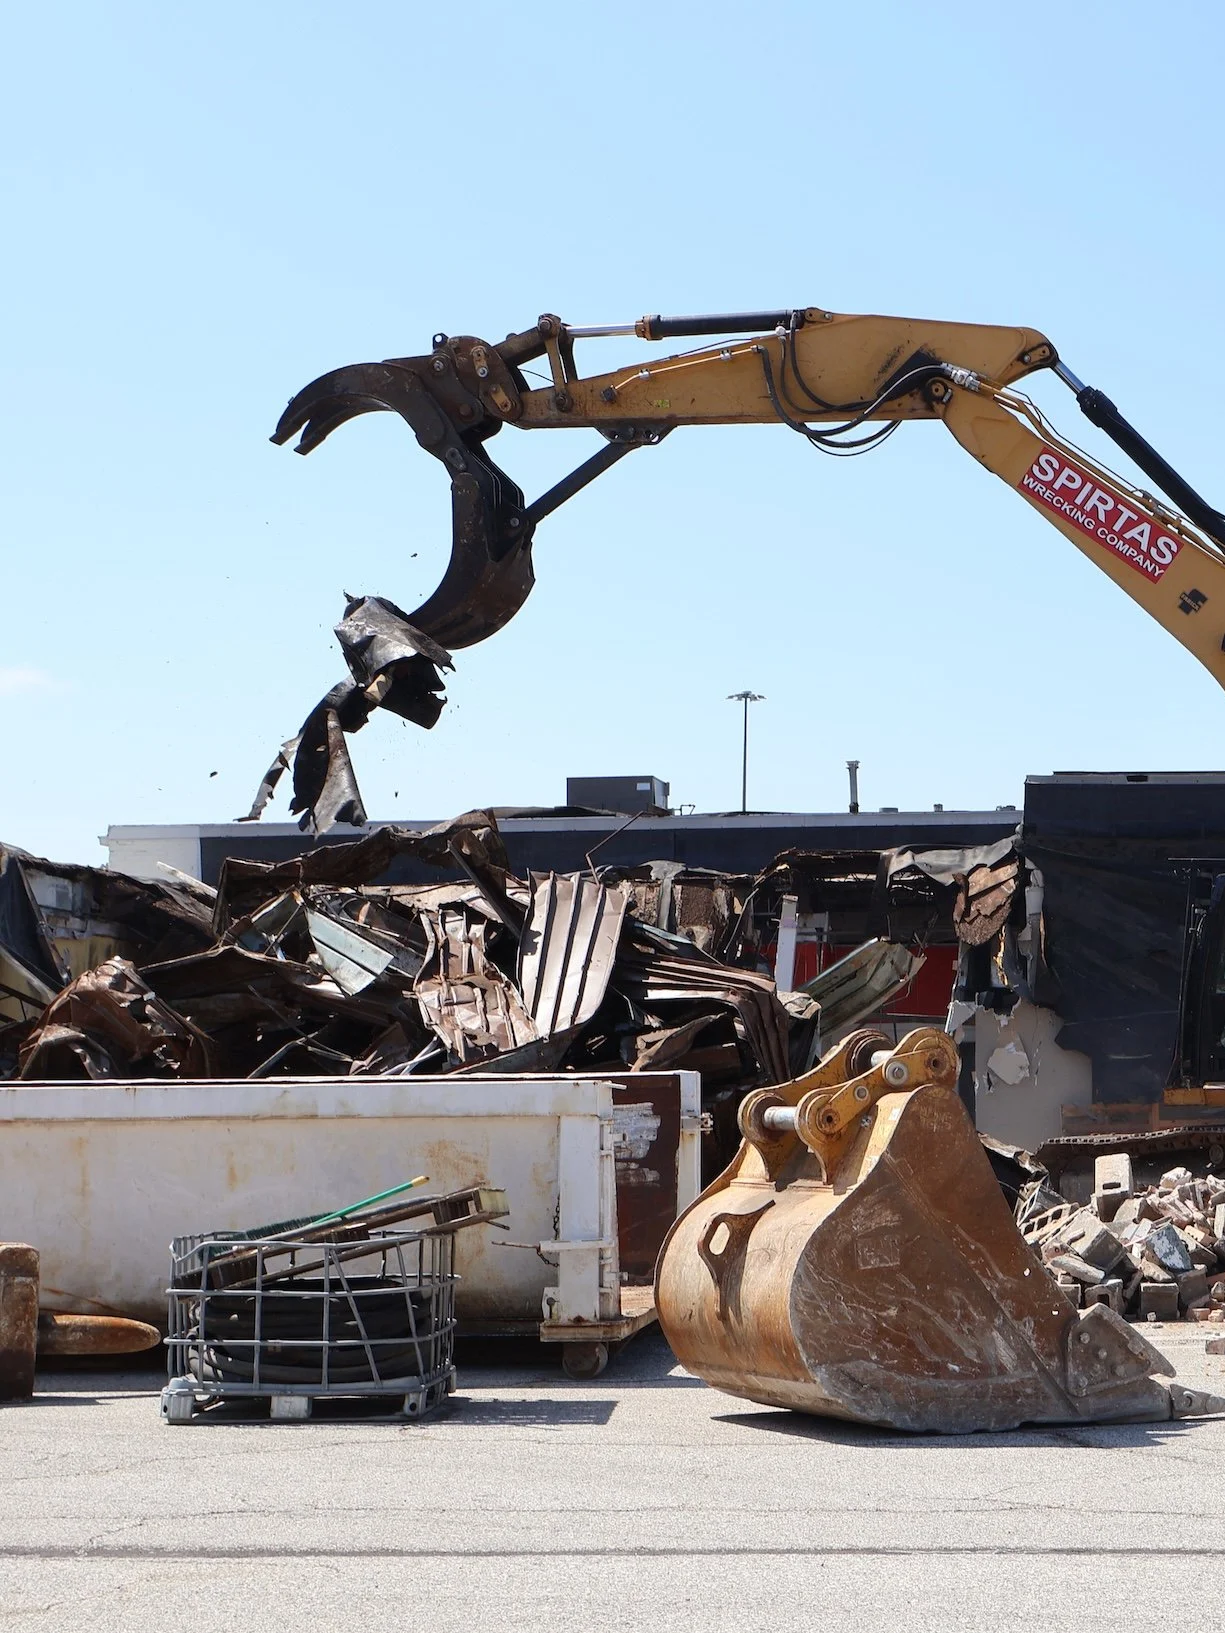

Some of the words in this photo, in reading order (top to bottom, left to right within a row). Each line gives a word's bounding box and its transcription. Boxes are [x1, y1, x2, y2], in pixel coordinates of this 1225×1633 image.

[1023, 475, 1096, 530] WRECKING
[1096, 527, 1165, 577] COMPANY
[1032, 453, 1178, 565] SPIRTAS
